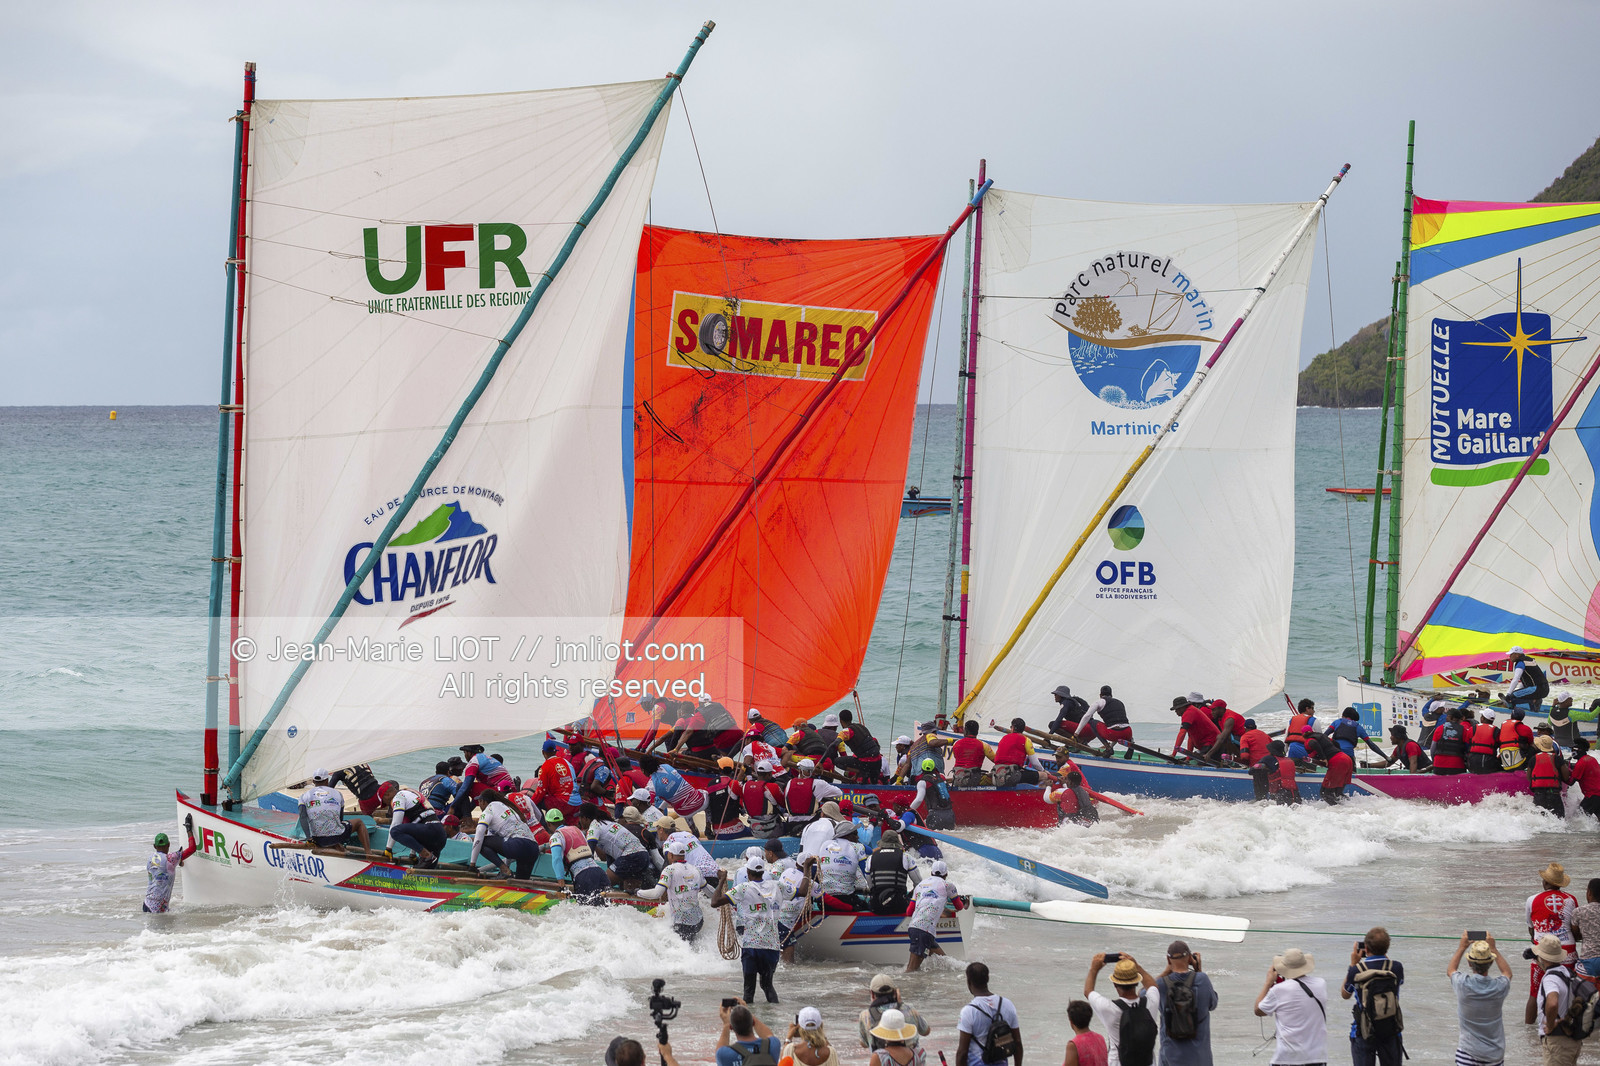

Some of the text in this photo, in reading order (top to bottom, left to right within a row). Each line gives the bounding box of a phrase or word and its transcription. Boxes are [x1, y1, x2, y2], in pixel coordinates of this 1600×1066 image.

[363, 223, 532, 295] UFR
[396, 295, 463, 312] FRATERNELLE
[467, 293, 486, 308] DES
[490, 290, 532, 307] REGIONS
[1055, 252, 1213, 331] Parc naturel marin
[1432, 323, 1451, 461] MUTUELLE
[1090, 420, 1179, 435] Martinie
[1457, 408, 1512, 430] Mare
[1457, 431, 1547, 454] Gaillard
[364, 507, 385, 526] EAU
[387, 497, 401, 510] DE
[453, 486, 466, 495] DE
[344, 534, 498, 605] CHANFLOR
[1096, 560, 1156, 585] OFB
[410, 599, 434, 613] DEPUIS
[1550, 660, 1600, 681] Orang
[231, 840, 253, 864] 40
[675, 884, 689, 895] UFR
[749, 903, 768, 912] UFR
